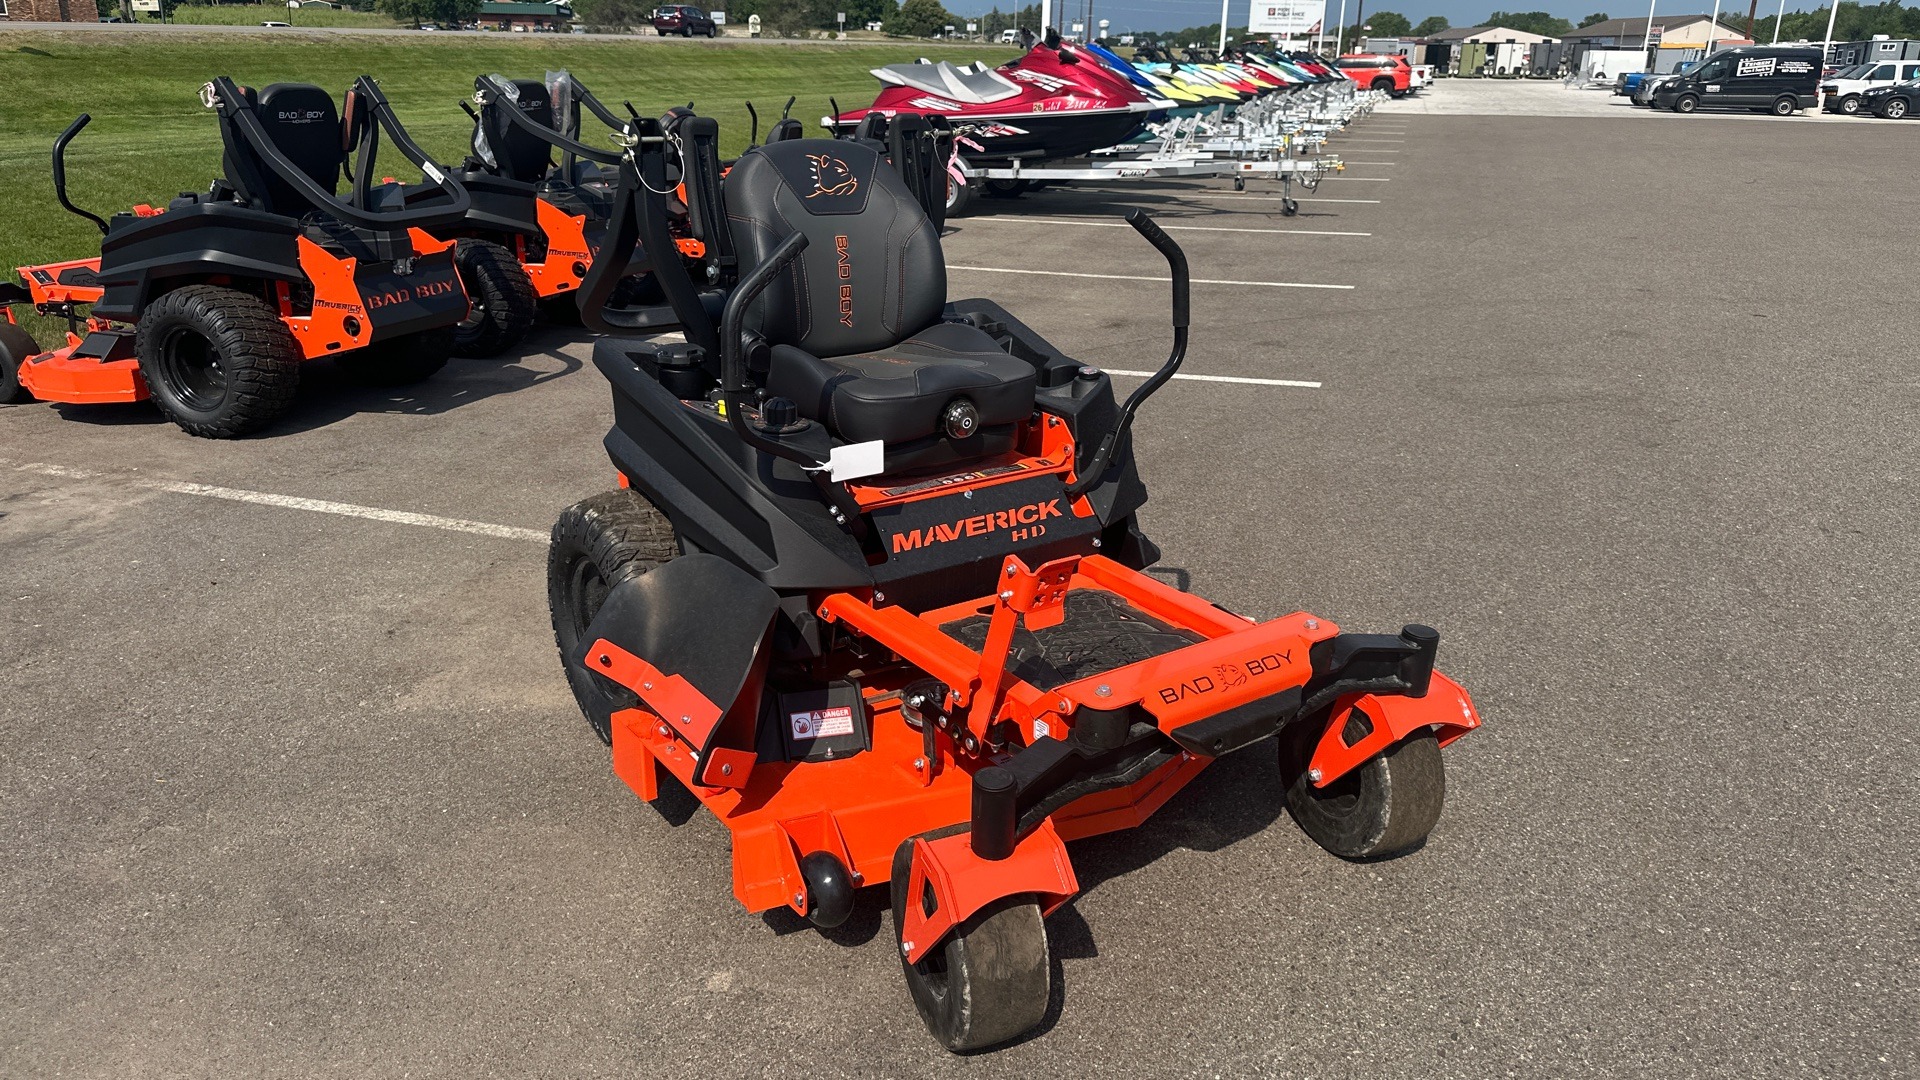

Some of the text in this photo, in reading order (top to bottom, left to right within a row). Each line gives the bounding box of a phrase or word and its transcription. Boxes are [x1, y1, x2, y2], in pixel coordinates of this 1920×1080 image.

[278, 111, 325, 119] BAD BOY
[1120, 169, 1147, 177] TRITON
[834, 235, 853, 328] BAD BOY
[367, 280, 453, 310] BAD BOY
[314, 299, 362, 311] MAVERICK
[892, 498, 1063, 554] MAVERICK
[1011, 524, 1046, 542] HD
[1158, 649, 1292, 705] BAD BOY
[822, 709, 850, 718] DANGER
